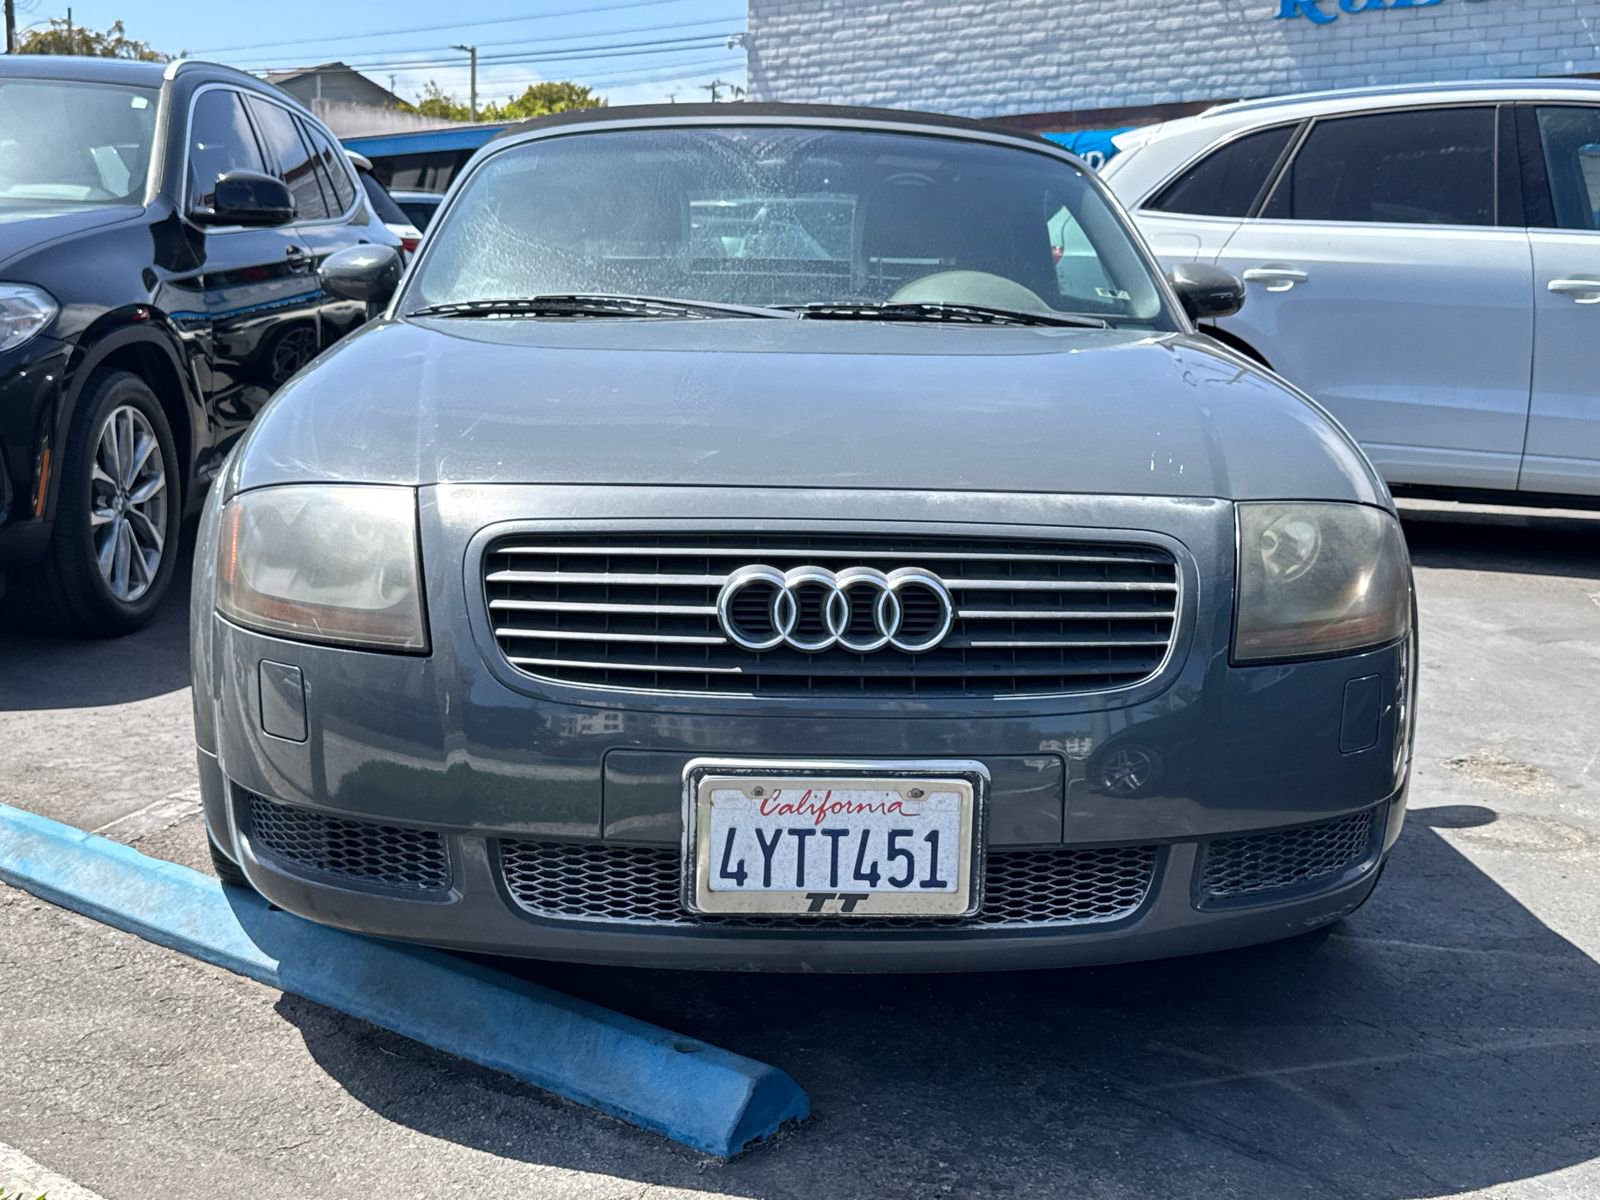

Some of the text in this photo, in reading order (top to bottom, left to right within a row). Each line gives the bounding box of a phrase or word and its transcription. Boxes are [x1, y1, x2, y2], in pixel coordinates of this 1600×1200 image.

[760, 789, 920, 825] California
[719, 827, 948, 888] 4YTT451
[805, 893, 869, 912] TT
